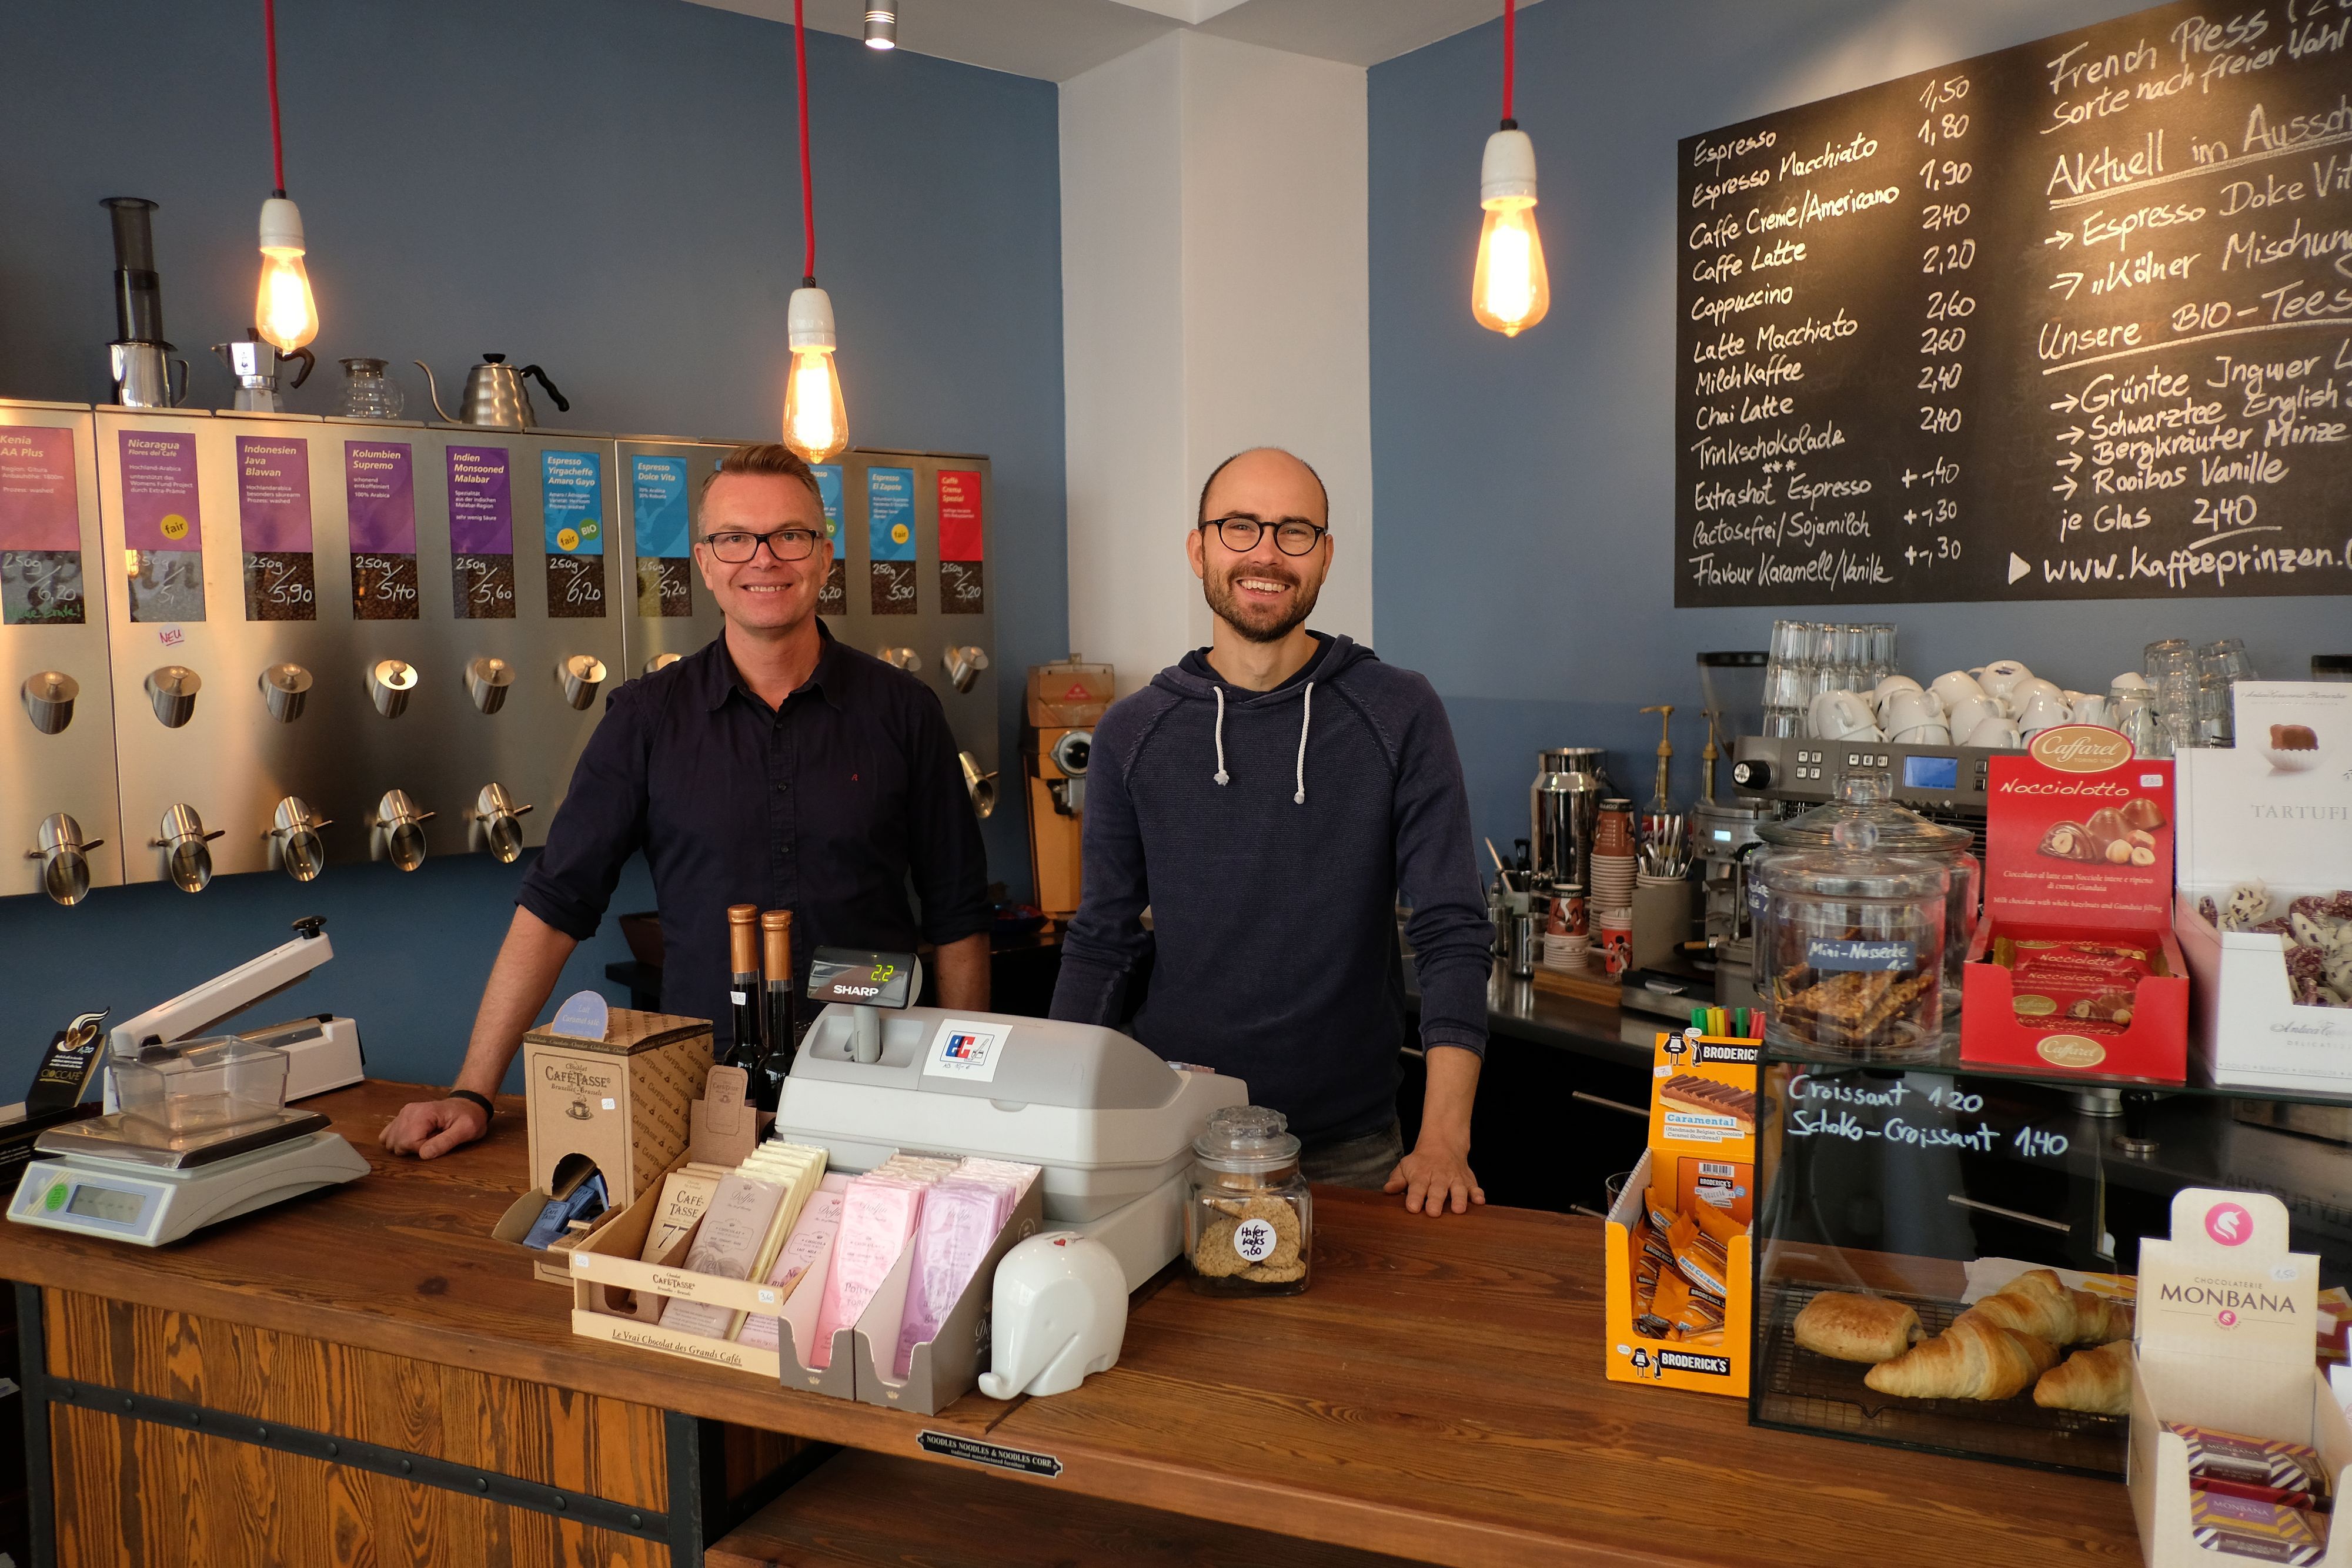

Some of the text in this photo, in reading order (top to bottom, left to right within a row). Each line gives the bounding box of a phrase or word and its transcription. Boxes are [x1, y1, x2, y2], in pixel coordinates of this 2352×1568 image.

[2046, 38, 2157, 93] French
[2171, 9, 2269, 62] Press
[2136, 64, 2194, 99] nach
[2201, 45, 2283, 93] freier
[1693, 75, 1970, 176] Espresso 1,50
[1691, 113, 1969, 209] Espresso Macchiato 1,80
[1689, 159, 1972, 250] Caffe Creme/Americano 1,90
[2083, 204, 2206, 251] Espresso
[1692, 203, 1970, 284] Caffe Latte 2,40
[1691, 239, 1976, 326] Cappuccino 2,20
[1693, 290, 1976, 363] Latte Macchiato 2,60
[1921, 327, 1966, 355] 2,60
[2039, 323, 2142, 360] Unsere
[2081, 365, 2190, 413] Grüntee
[2207, 355, 2321, 403] Ingwer
[1696, 363, 1962, 431] Chai Latte 2,40
[2089, 397, 2227, 441] Schwarztee
[2243, 379, 2338, 423] English
[0, 436, 32, 445] Kenia
[128, 439, 179, 450] Nicaragua
[1690, 407, 1962, 470] Trinkschokolade 2,40
[2092, 416, 2350, 473] Bergkräuter Minze
[1, 448, 44, 457] AA Plus
[244, 445, 296, 454] Indonesien
[353, 450, 401, 460] Kolumbien
[453, 453, 480, 462] Indien
[245, 456, 266, 465] Java
[353, 460, 393, 470] Supremo
[454, 463, 504, 474] Monsooned
[547, 456, 582, 466] Espresso
[638, 463, 670, 472] Espresso
[246, 468, 281, 477] Blawan
[455, 474, 490, 484] Malabar
[548, 466, 593, 477] Yirgacheffe
[638, 472, 675, 482] Dolce Vita
[873, 474, 900, 483] Espresso
[2093, 451, 2290, 494] Rooibos Vanille
[548, 477, 595, 487] Amaro Gayo
[1695, 476, 1776, 511] Extrashot
[1787, 473, 1872, 510] Espresso
[164, 521, 185, 534] fair
[2060, 495, 2257, 543] je Glas 2,40
[581, 524, 597, 536] BIO
[560, 534, 575, 547] fair
[1689, 552, 1755, 586] Flavour
[38, 580, 76, 603] 6,20
[270, 584, 312, 606] 5,90
[377, 582, 416, 601] 5,40
[473, 583, 512, 606] 5,60
[567, 579, 601, 605] 6,20
[658, 580, 687, 598] 5,20
[159, 629, 182, 644] NEU
[2042, 736, 2123, 763] Caffarel
[2000, 778, 2130, 797] Nocciolotto
[2251, 804, 2348, 820] TARTUFI
[2040, 952, 2116, 967] Nocciolotto
[870, 964, 894, 982] 2.2
[833, 985, 879, 997] SHARP
[2044, 1040, 2097, 1057] Caffarel
[1788, 1074, 1910, 1106] Croissant
[1667, 1114, 1735, 1126] Caramental
[2014, 1126, 2069, 1156] 1,40
[670, 1203, 699, 1218] TASSE
[1241, 1225, 1268, 1237] Hafer
[1679, 1257, 1695, 1272] Mini
[844, 1282, 874, 1295] Poivre
[2194, 1277, 2263, 1289] CHOCOLATERIE
[2161, 1284, 2296, 1314] MONBANA
[612, 1329, 742, 1364] Le Vrai Chocolat des Grands Cafés
[1662, 1352, 1727, 1373] BRODERICK'S
[926, 1435, 957, 1449] NOODLES
[958, 1442, 990, 1455] NOODLES
[998, 1450, 1030, 1463] NOODLES
[2207, 1444, 2260, 1456] MONBANA
[971, 1455, 1003, 1465] manufactured
[1004, 1460, 1025, 1469] furniture
[2213, 1500, 2269, 1517] MONBANA
